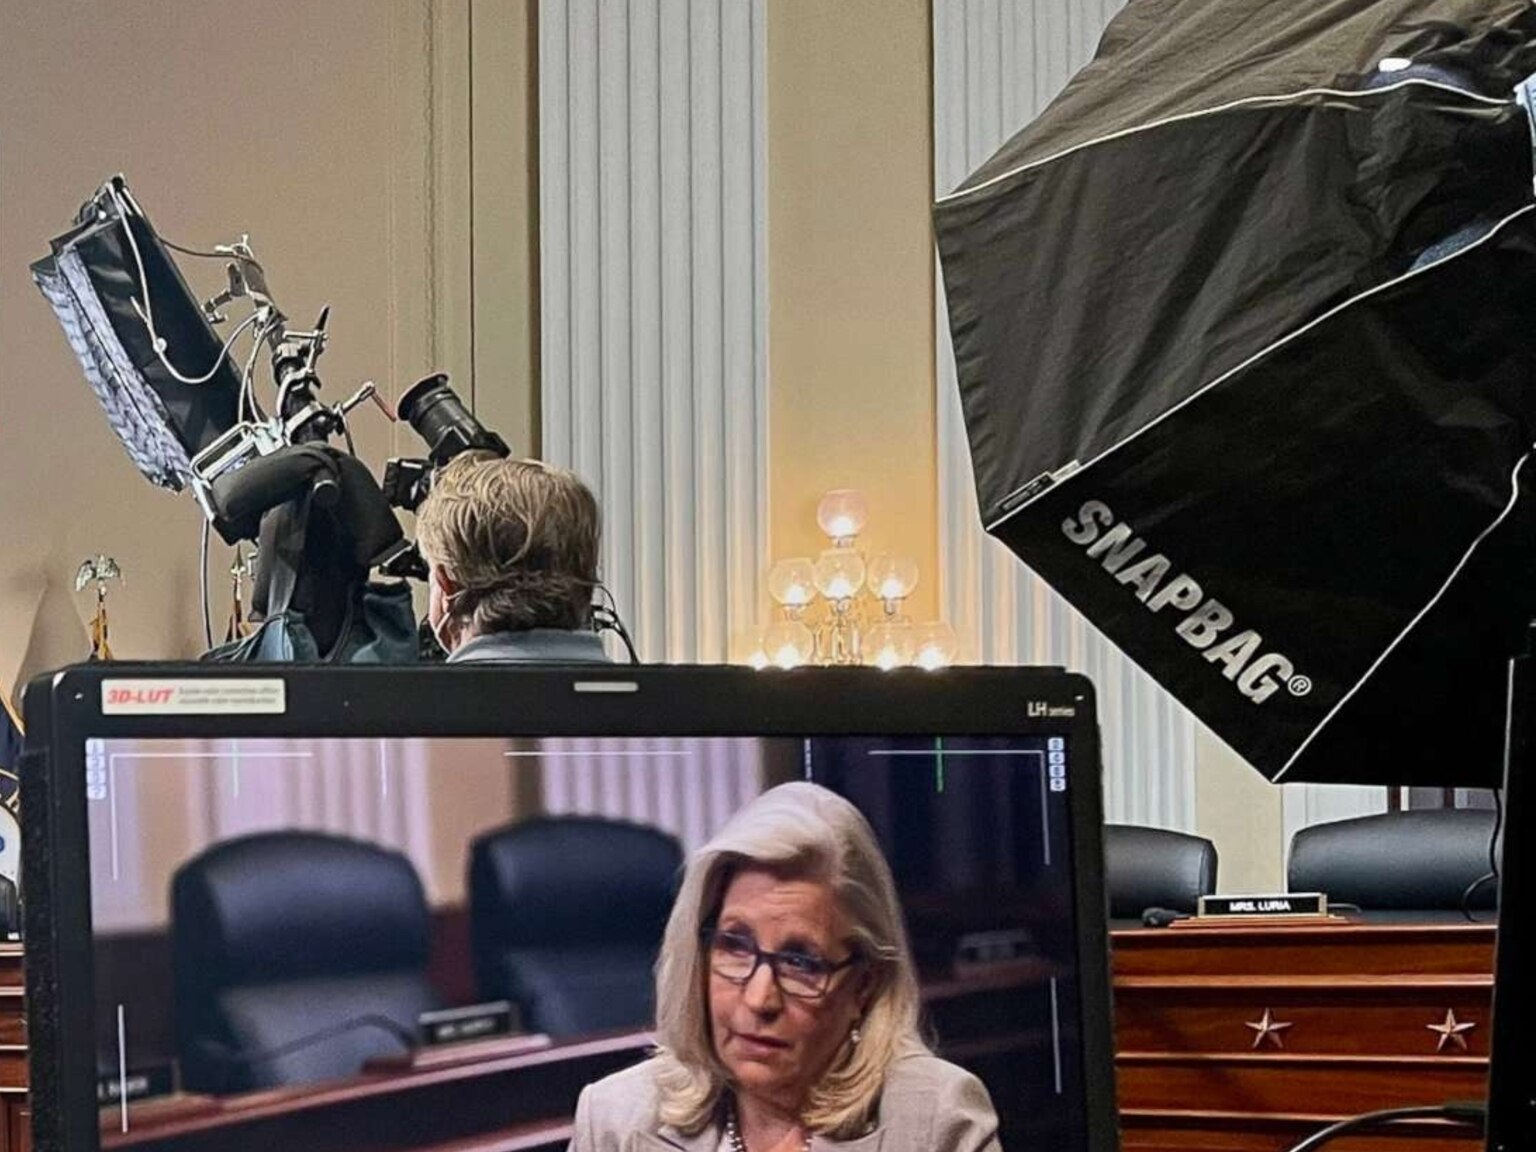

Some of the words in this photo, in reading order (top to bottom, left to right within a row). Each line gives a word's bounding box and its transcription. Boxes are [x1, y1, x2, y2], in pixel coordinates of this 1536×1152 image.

[107, 687, 174, 705] 3D-LUT
[1027, 701, 1047, 717] LH
[1229, 901, 1256, 912] MRS.
[1257, 900, 1292, 911] LURIA
